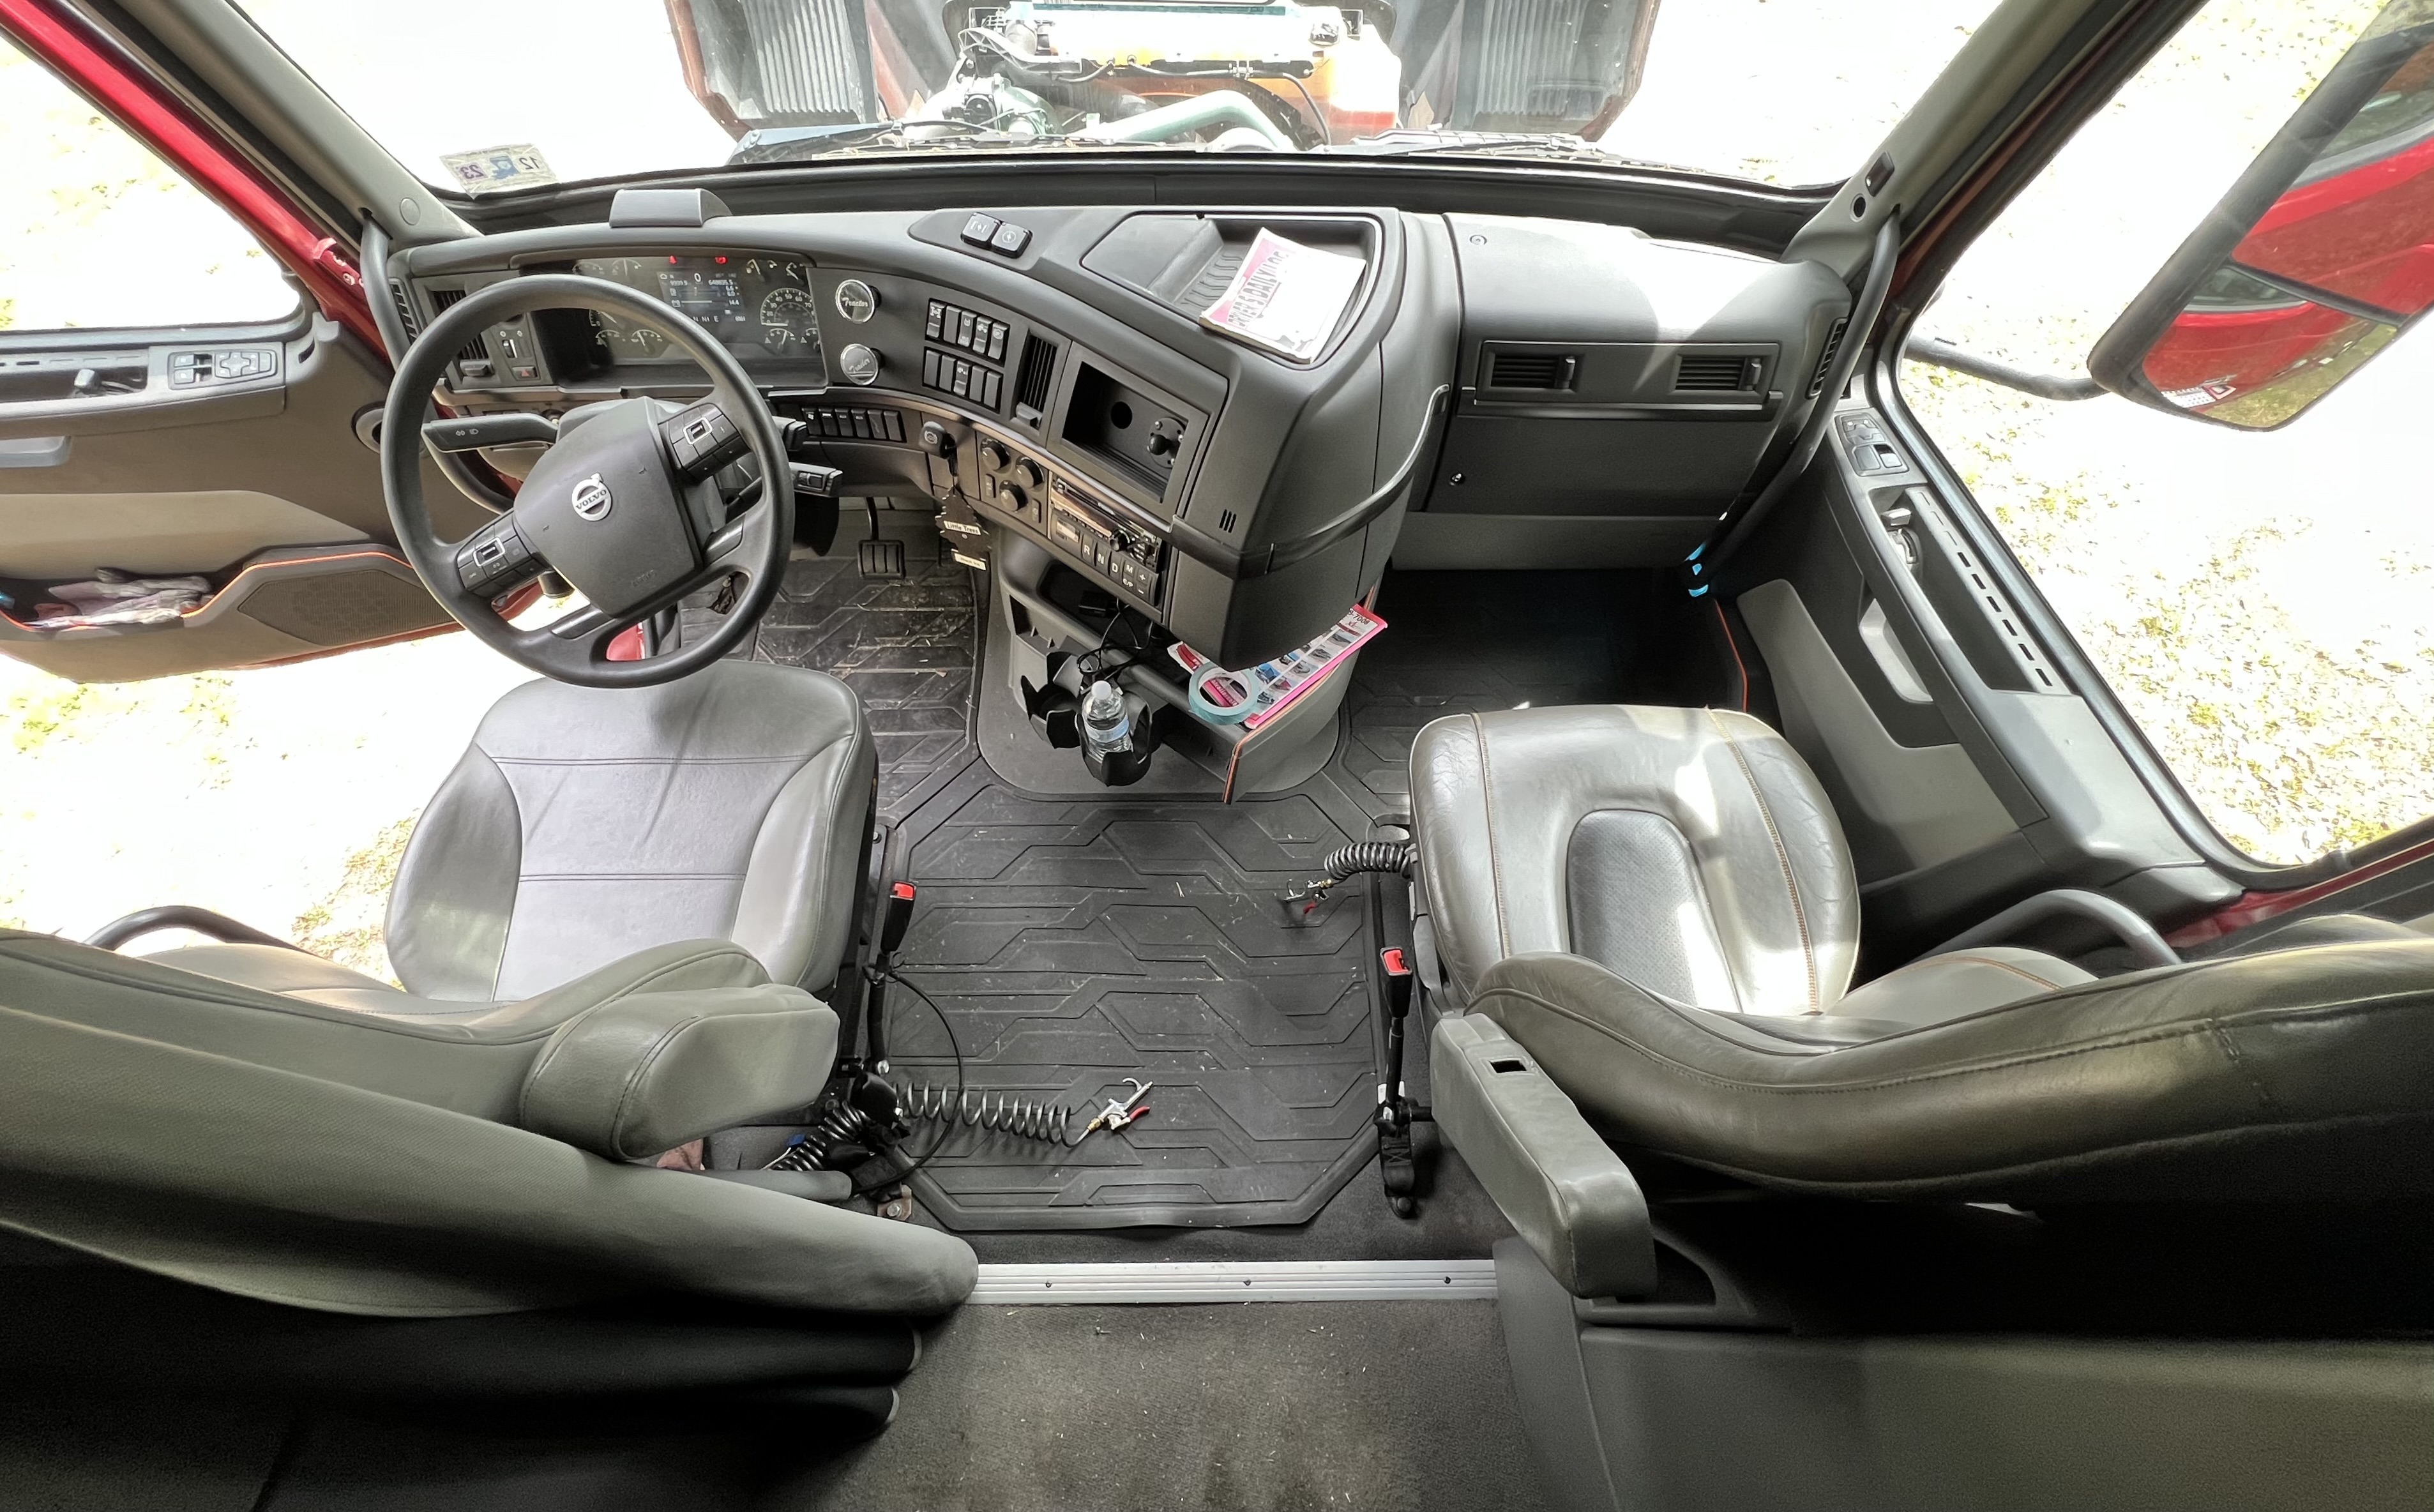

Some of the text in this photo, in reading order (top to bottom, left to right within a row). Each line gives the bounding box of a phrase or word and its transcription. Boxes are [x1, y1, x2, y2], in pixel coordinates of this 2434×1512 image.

[693, 273, 702, 282] 0
[1243, 268, 1278, 299] DAILY
[842, 297, 868, 307] Tractor
[575, 489, 607, 510] VOLVO
[947, 521, 979, 534] Little Trees
[1084, 544, 1090, 556] R
[1098, 553, 1104, 564] N
[1112, 563, 1118, 573] D
[1126, 564, 1133, 573] M
